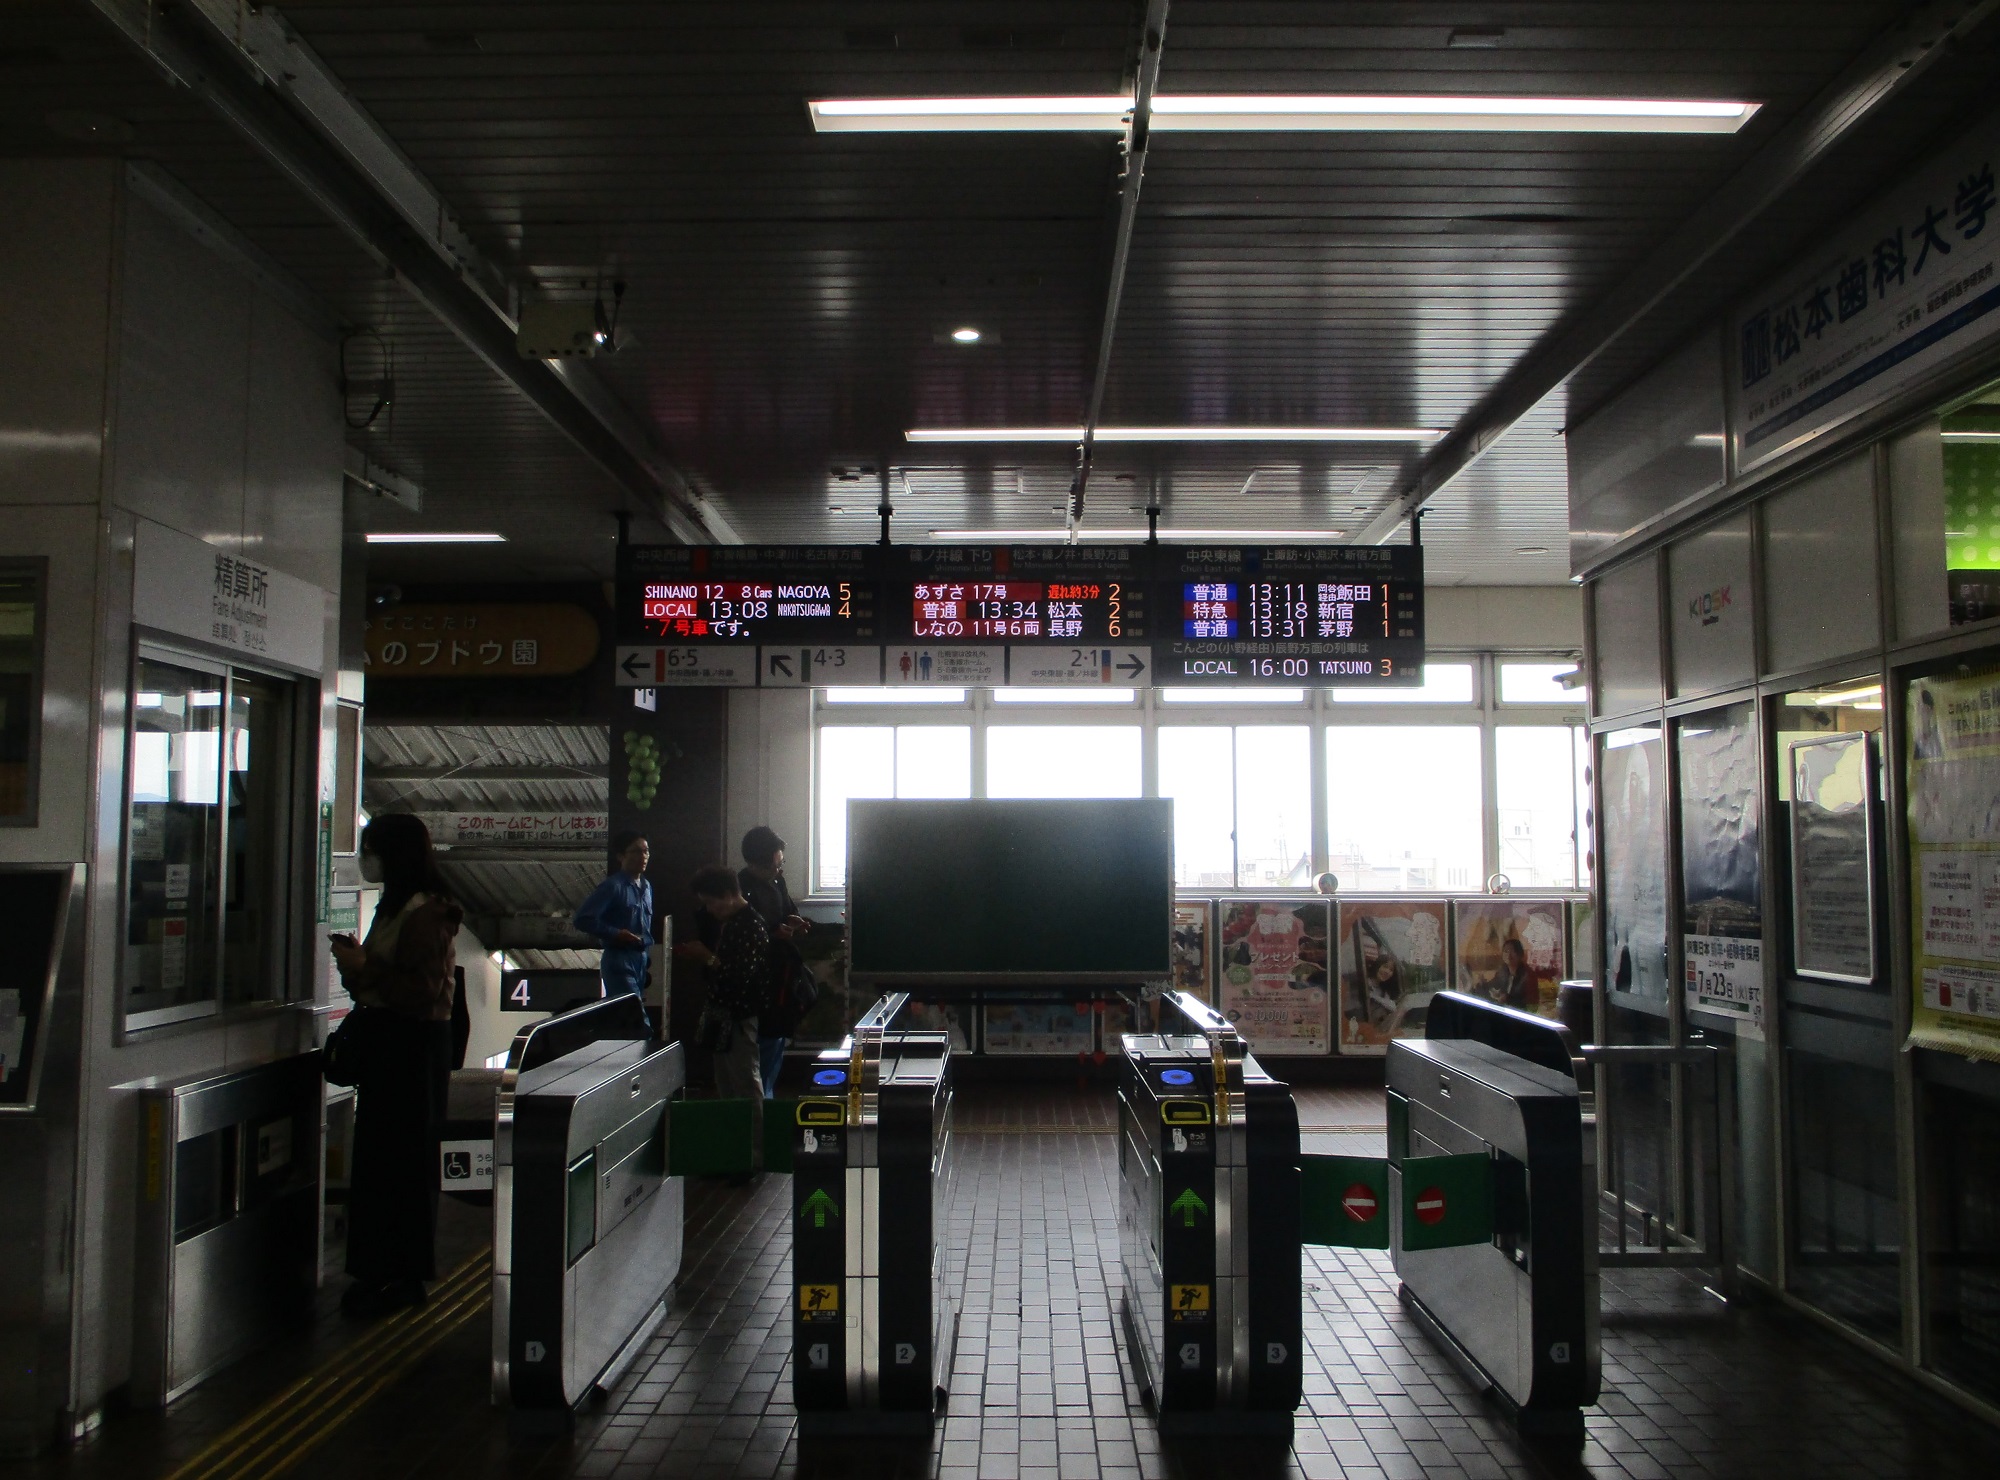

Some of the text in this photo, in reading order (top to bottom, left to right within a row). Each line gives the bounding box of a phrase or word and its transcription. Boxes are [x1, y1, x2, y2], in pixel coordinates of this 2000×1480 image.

[1773, 162, 1996, 365] 松本歯科大学
[1186, 549, 1242, 563] 中央東線
[214, 553, 268, 608] 精算所
[1318, 584, 1337, 593] 岡谷
[645, 585, 698, 599] SHINANO
[704, 585, 724, 599] 12
[741, 586, 751, 599] 8
[754, 586, 772, 599] Cars
[778, 585, 831, 599] NAGOYA
[839, 583, 851, 601] 5
[914, 585, 965, 600] あずさ
[973, 585, 1007, 599] 17号
[1047, 585, 1100, 600] 遅れ約3分
[1108, 583, 1121, 601] 2
[1193, 584, 1228, 601] 普通
[1249, 584, 1305, 601] 13:11
[1336, 584, 1371, 602] 飯田
[1381, 583, 1389, 601] 1
[1318, 593, 1337, 602] 経由
[213, 595, 268, 629] Fare Adjustment
[644, 603, 697, 617] LOCAL
[710, 601, 768, 619] 13:08
[777, 603, 831, 617] NAKATSUGAWA
[838, 601, 852, 619] 4
[922, 601, 958, 619] 普通
[979, 602, 1038, 619] 13:34
[1047, 601, 1083, 619] 松本
[1108, 601, 1121, 619] 2
[1193, 602, 1228, 620] 特急
[1249, 602, 1308, 619] 13:18
[1318, 602, 1354, 620] 新宿
[1381, 602, 1389, 619] 1
[914, 621, 964, 636] しなの
[1047, 620, 1083, 637] 長野
[1108, 620, 1121, 637] 6
[1193, 620, 1228, 637] 普通
[1249, 620, 1305, 637] 13:31
[1318, 620, 1354, 637] 茅野
[1381, 620, 1389, 637] 1
[1184, 661, 1238, 675] LOCAL
[1249, 658, 1309, 677] 16:00
[1319, 661, 1372, 675] TATSUNO
[1380, 658, 1393, 677] 3
[457, 816, 608, 830] このホームにトイレはあり
[510, 979, 531, 1007] 4
[530, 1345, 537, 1358] 1
[816, 1347, 823, 1360] 1
[900, 1347, 909, 1360] 2
[1187, 1347, 1196, 1360] 2
[1271, 1347, 1281, 1359] 3
[1557, 1346, 1566, 1359] 3
